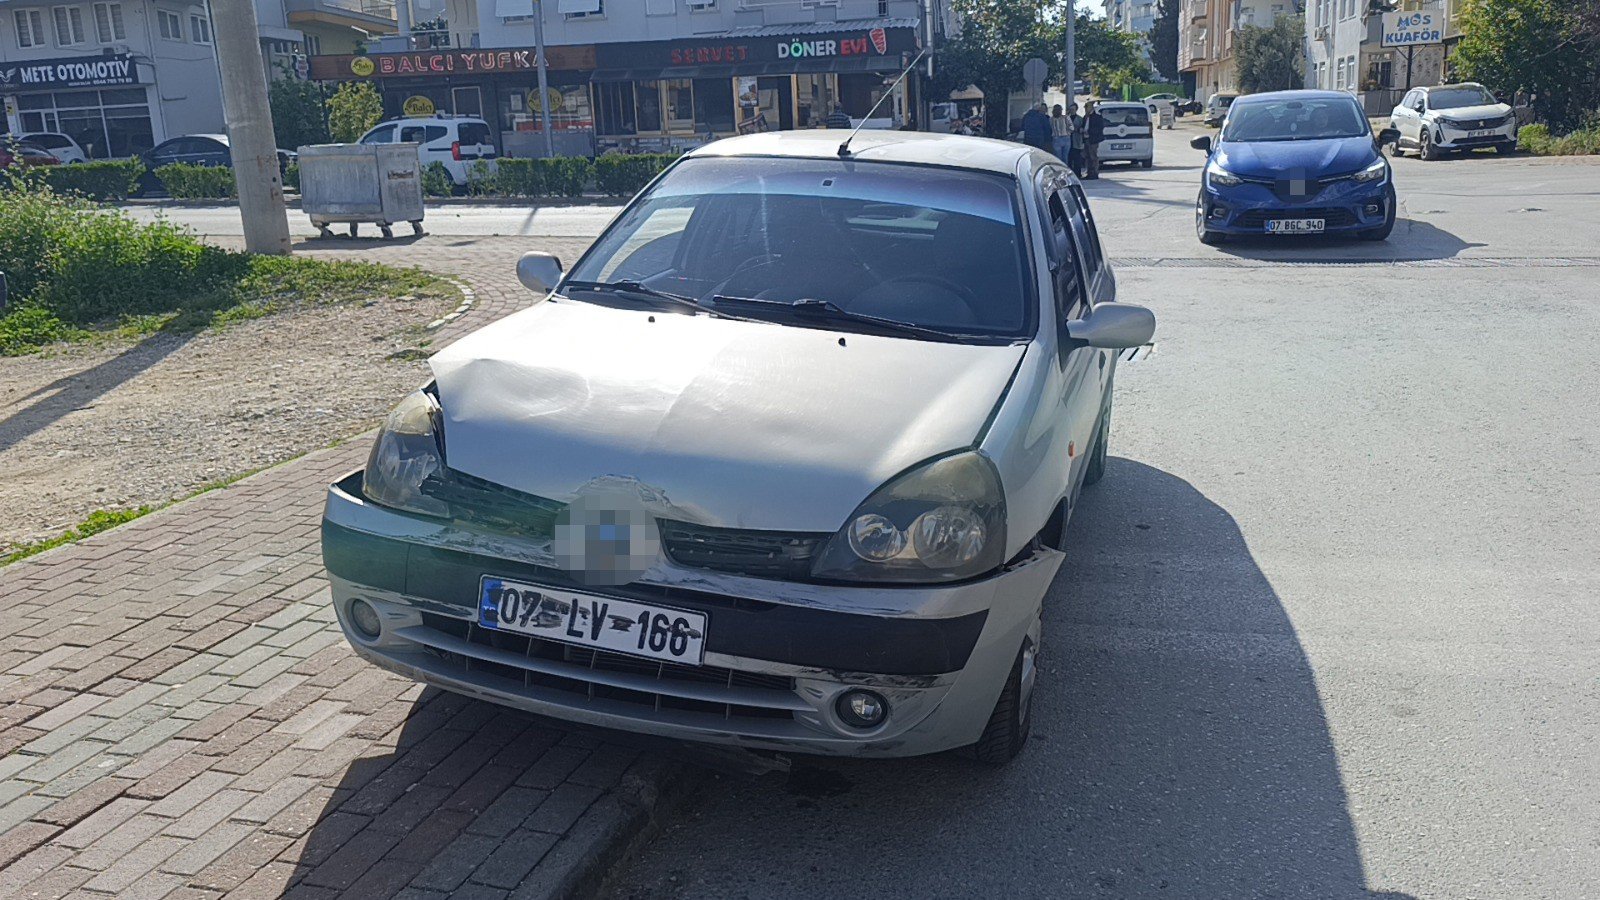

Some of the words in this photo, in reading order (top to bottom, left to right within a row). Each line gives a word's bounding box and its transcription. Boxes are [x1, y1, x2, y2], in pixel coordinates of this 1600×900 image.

[1386, 28, 1440, 43] KUAFÖR
[671, 45, 748, 63] SERVET
[777, 38, 837, 59] DÖNER
[840, 36, 867, 56] EVİ
[20, 65, 55, 83] METE
[57, 56, 130, 80] OTOMOTİV
[380, 54, 453, 74] BALCI
[1270, 220, 1281, 230] 07
[1284, 220, 1302, 230] BGC
[1305, 220, 1323, 230] 940
[501, 587, 542, 627] 07
[566, 598, 608, 641] LV
[637, 610, 691, 657] 166
